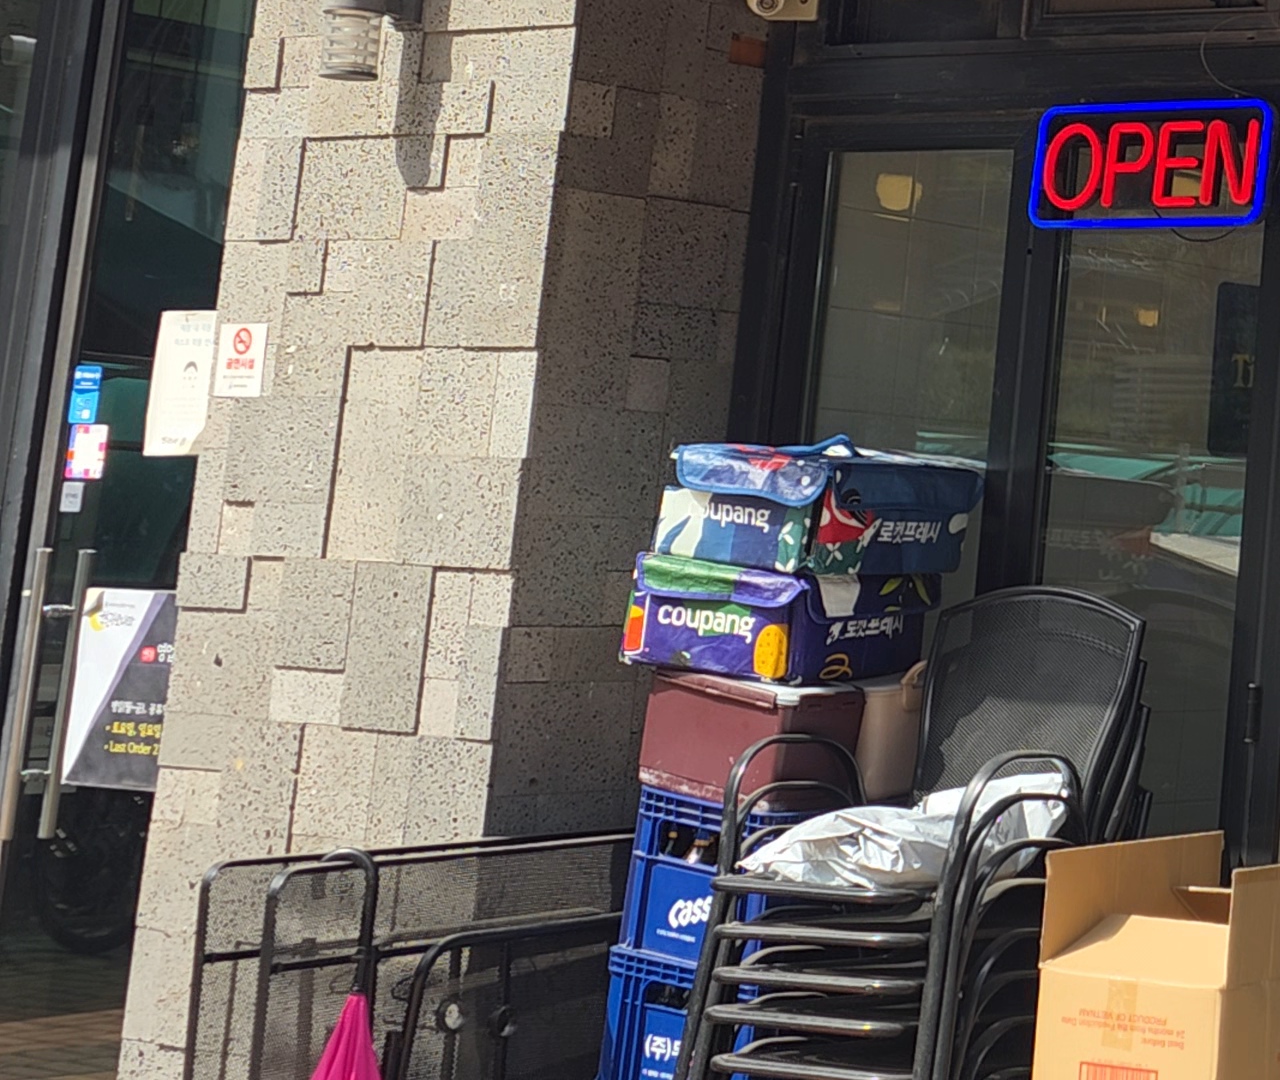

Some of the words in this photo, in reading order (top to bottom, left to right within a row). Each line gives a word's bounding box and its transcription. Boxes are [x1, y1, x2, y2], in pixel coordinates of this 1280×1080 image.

[1043, 118, 1260, 211] OPEN
[877, 521, 941, 544] 로켓프레시
[657, 602, 756, 644] coupang
